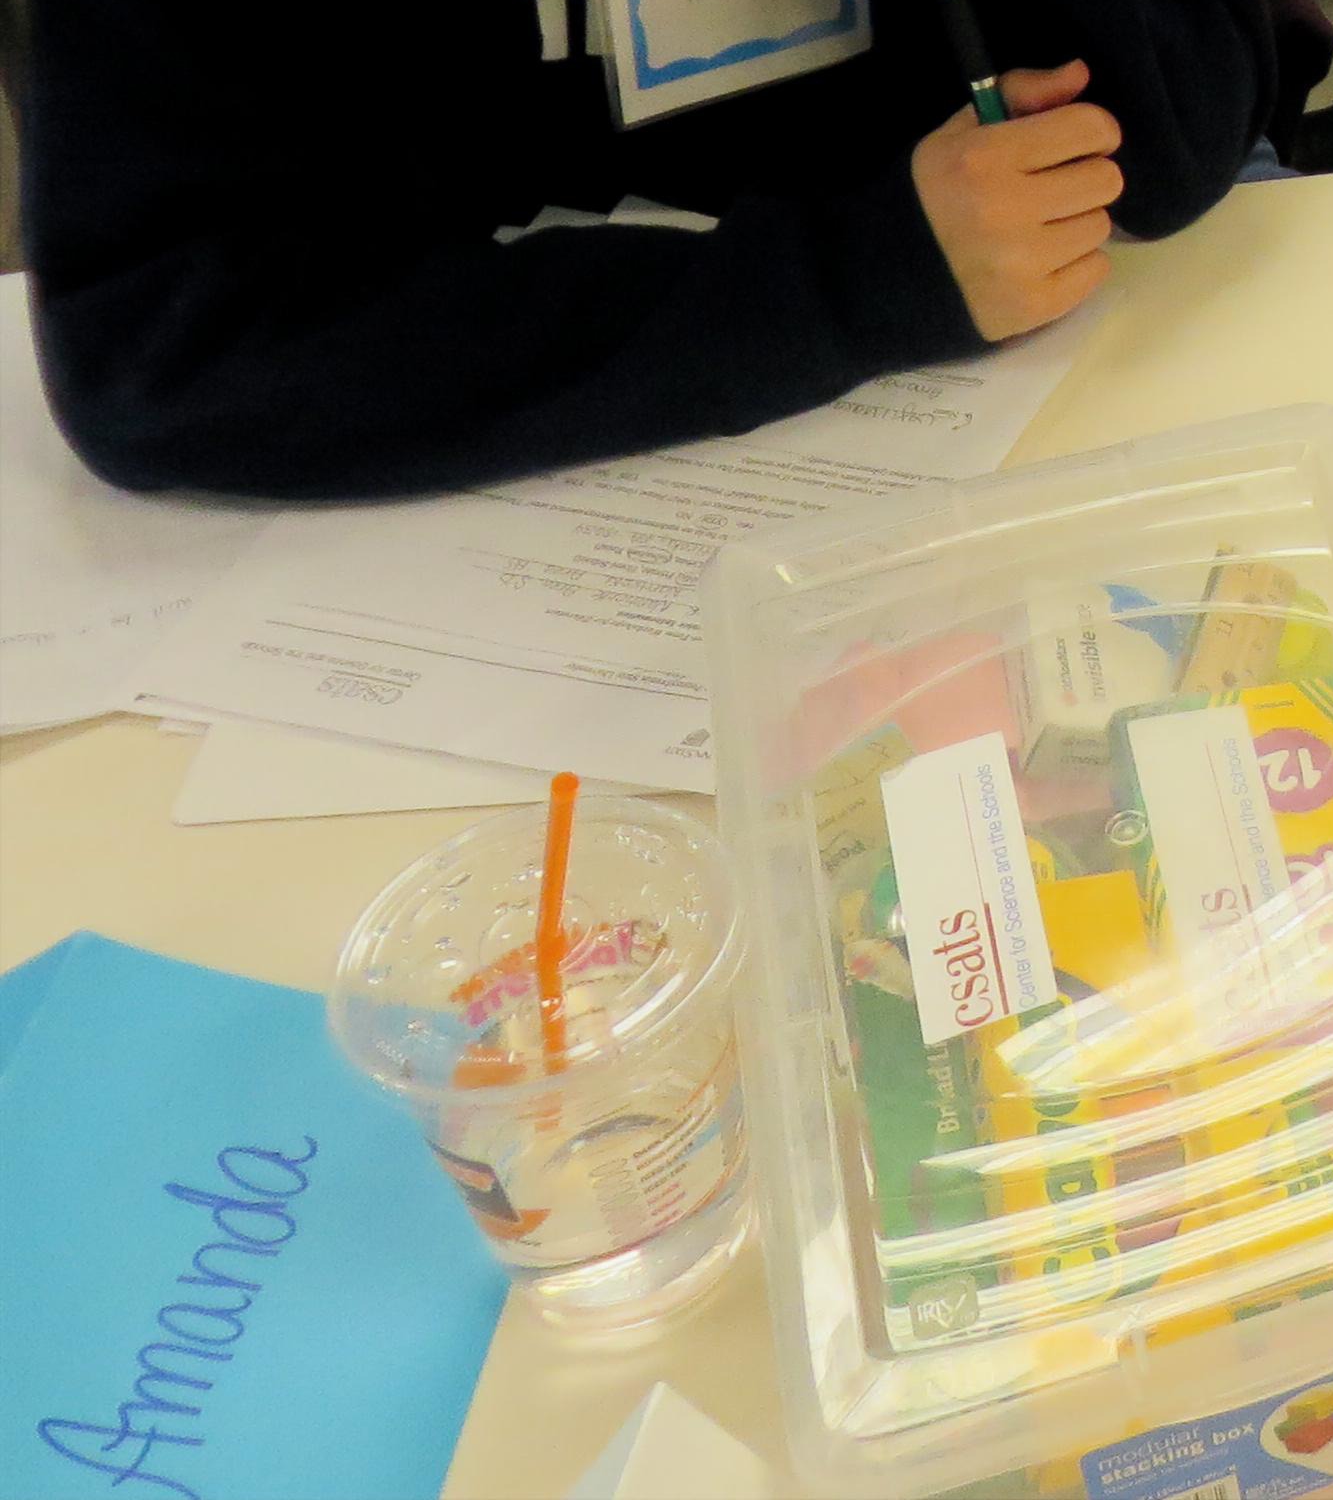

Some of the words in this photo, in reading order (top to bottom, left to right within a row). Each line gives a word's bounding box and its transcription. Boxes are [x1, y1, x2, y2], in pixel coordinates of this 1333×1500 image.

[976, 762, 1001, 820] Schools
[1223, 736, 1249, 797] Schools
[1257, 747, 1324, 793] 12
[987, 819, 1004, 845] the
[1239, 798, 1258, 823] the
[996, 845, 1011, 873] and
[1246, 824, 1265, 851] and
[1000, 874, 1023, 933] Science
[932, 908, 994, 1027] csats
[1009, 935, 1028, 957] for
[1016, 959, 1038, 1009] Center
[36, 1134, 319, 1499] Amanda
[1101, 1439, 1206, 1485] stacking
[1212, 1421, 1256, 1447] box
